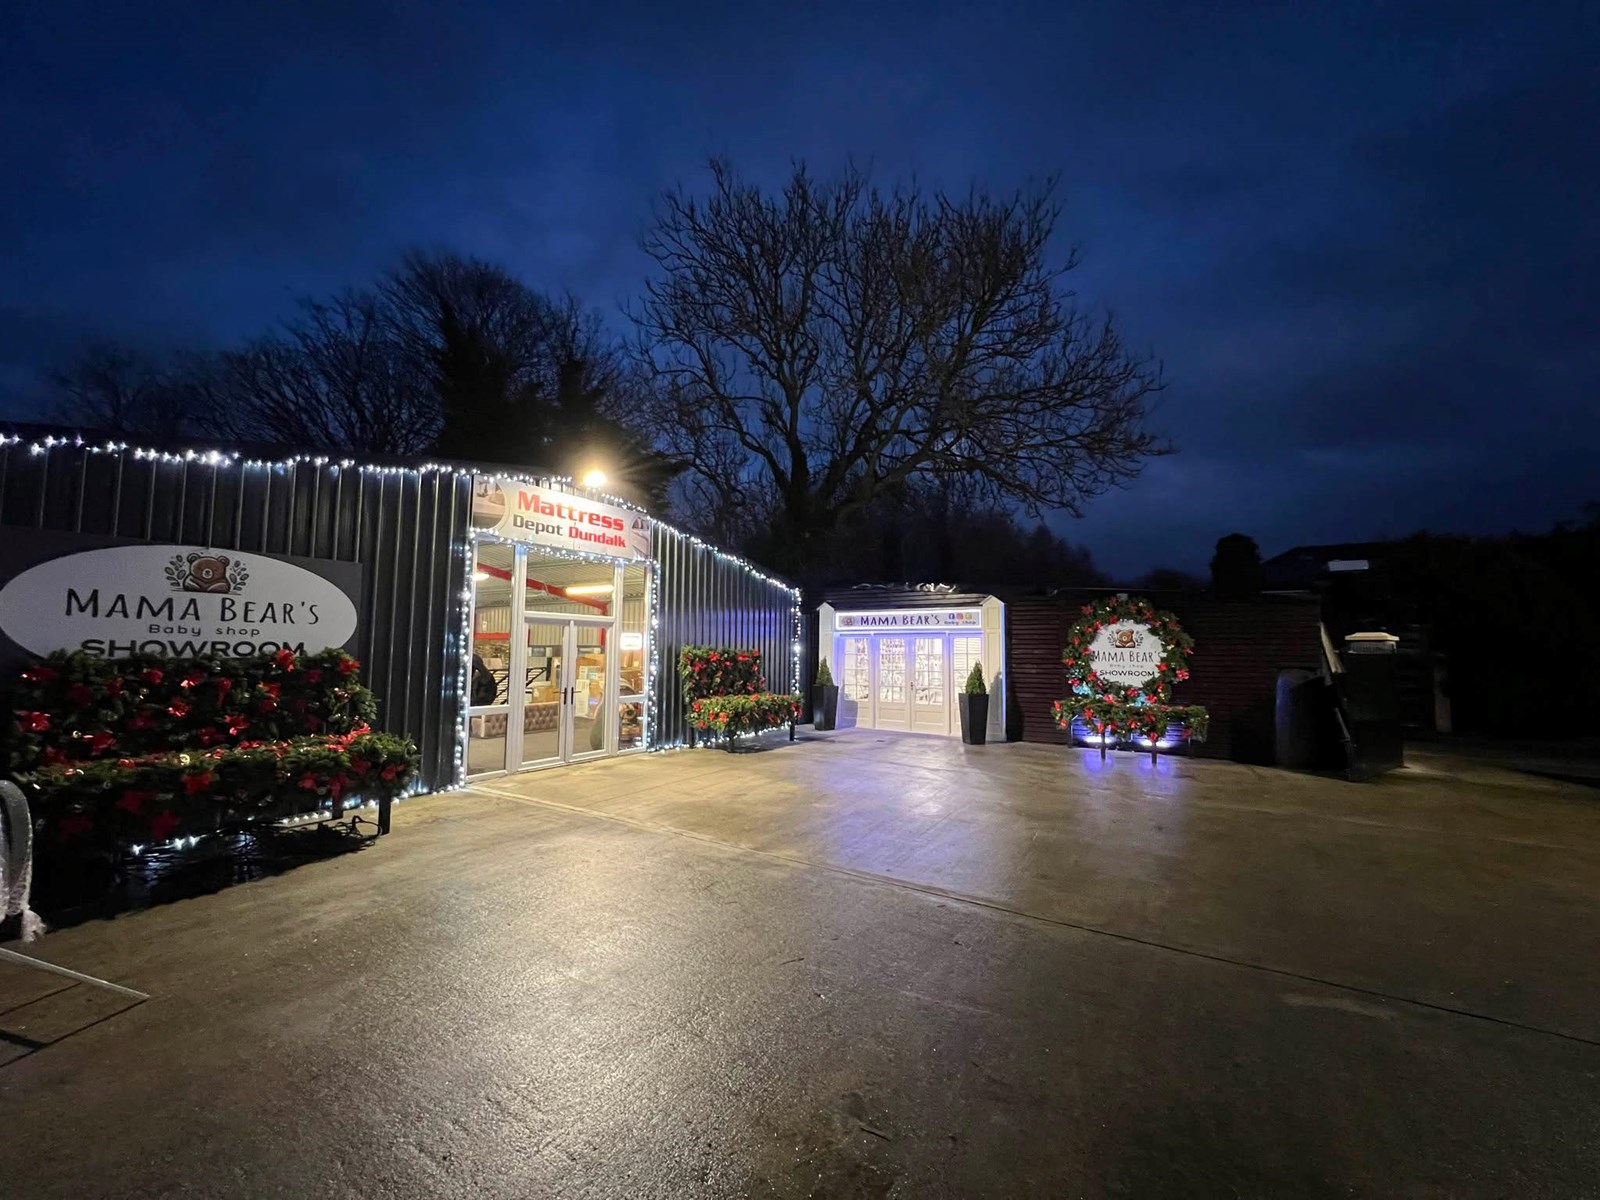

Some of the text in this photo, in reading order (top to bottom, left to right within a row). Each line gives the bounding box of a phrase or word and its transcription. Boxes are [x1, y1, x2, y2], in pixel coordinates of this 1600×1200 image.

[518, 490, 625, 531] Mattress
[513, 514, 626, 548] Depot Dundalk
[65, 588, 319, 625] MAMA BEAR'S
[860, 613, 940, 626] MAMA BEAR'S
[149, 624, 260, 637] Baby shop
[81, 638, 305, 658] SHOWROOM
[1090, 650, 1125, 662] MAMA
